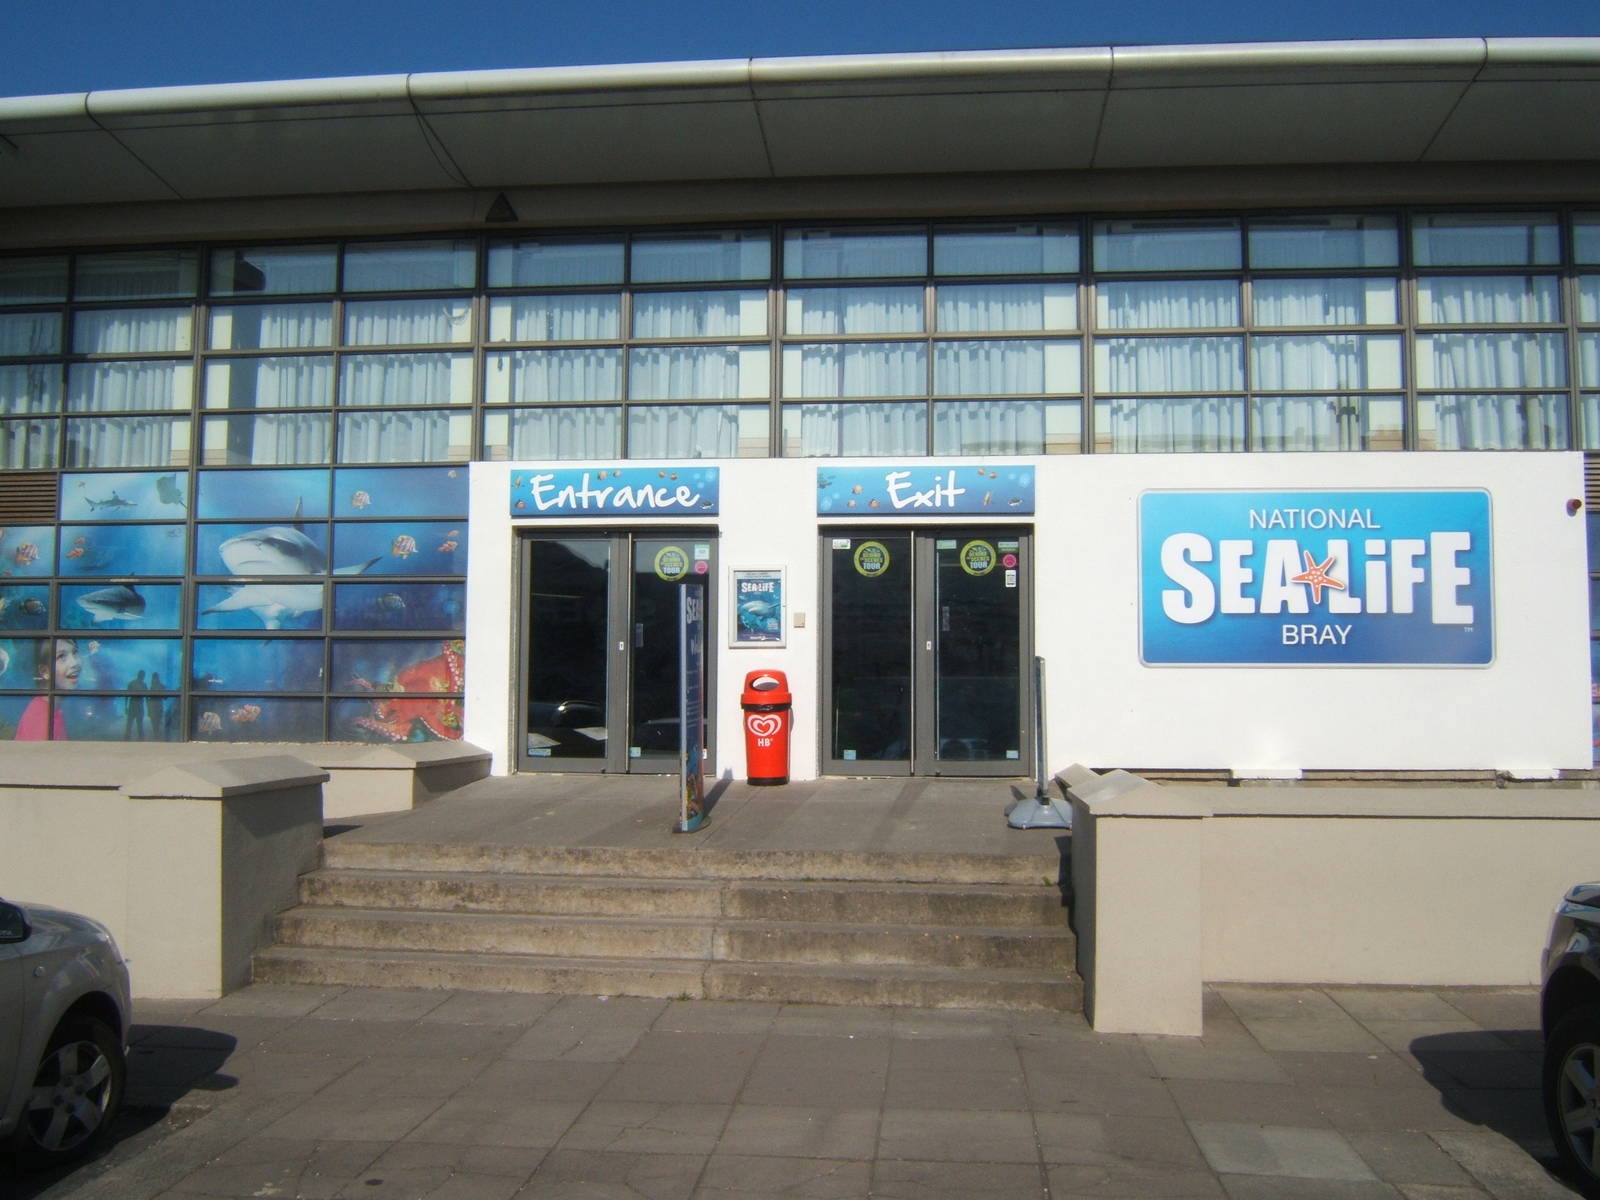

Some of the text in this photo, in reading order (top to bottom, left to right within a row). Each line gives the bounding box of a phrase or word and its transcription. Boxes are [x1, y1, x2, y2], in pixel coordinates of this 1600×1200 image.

[529, 472, 702, 511] Entrance
[886, 469, 967, 509] Exit
[1249, 508, 1382, 531] NATIONAL
[1281, 624, 1353, 646] BRAY
[757, 737, 771, 748] HB
